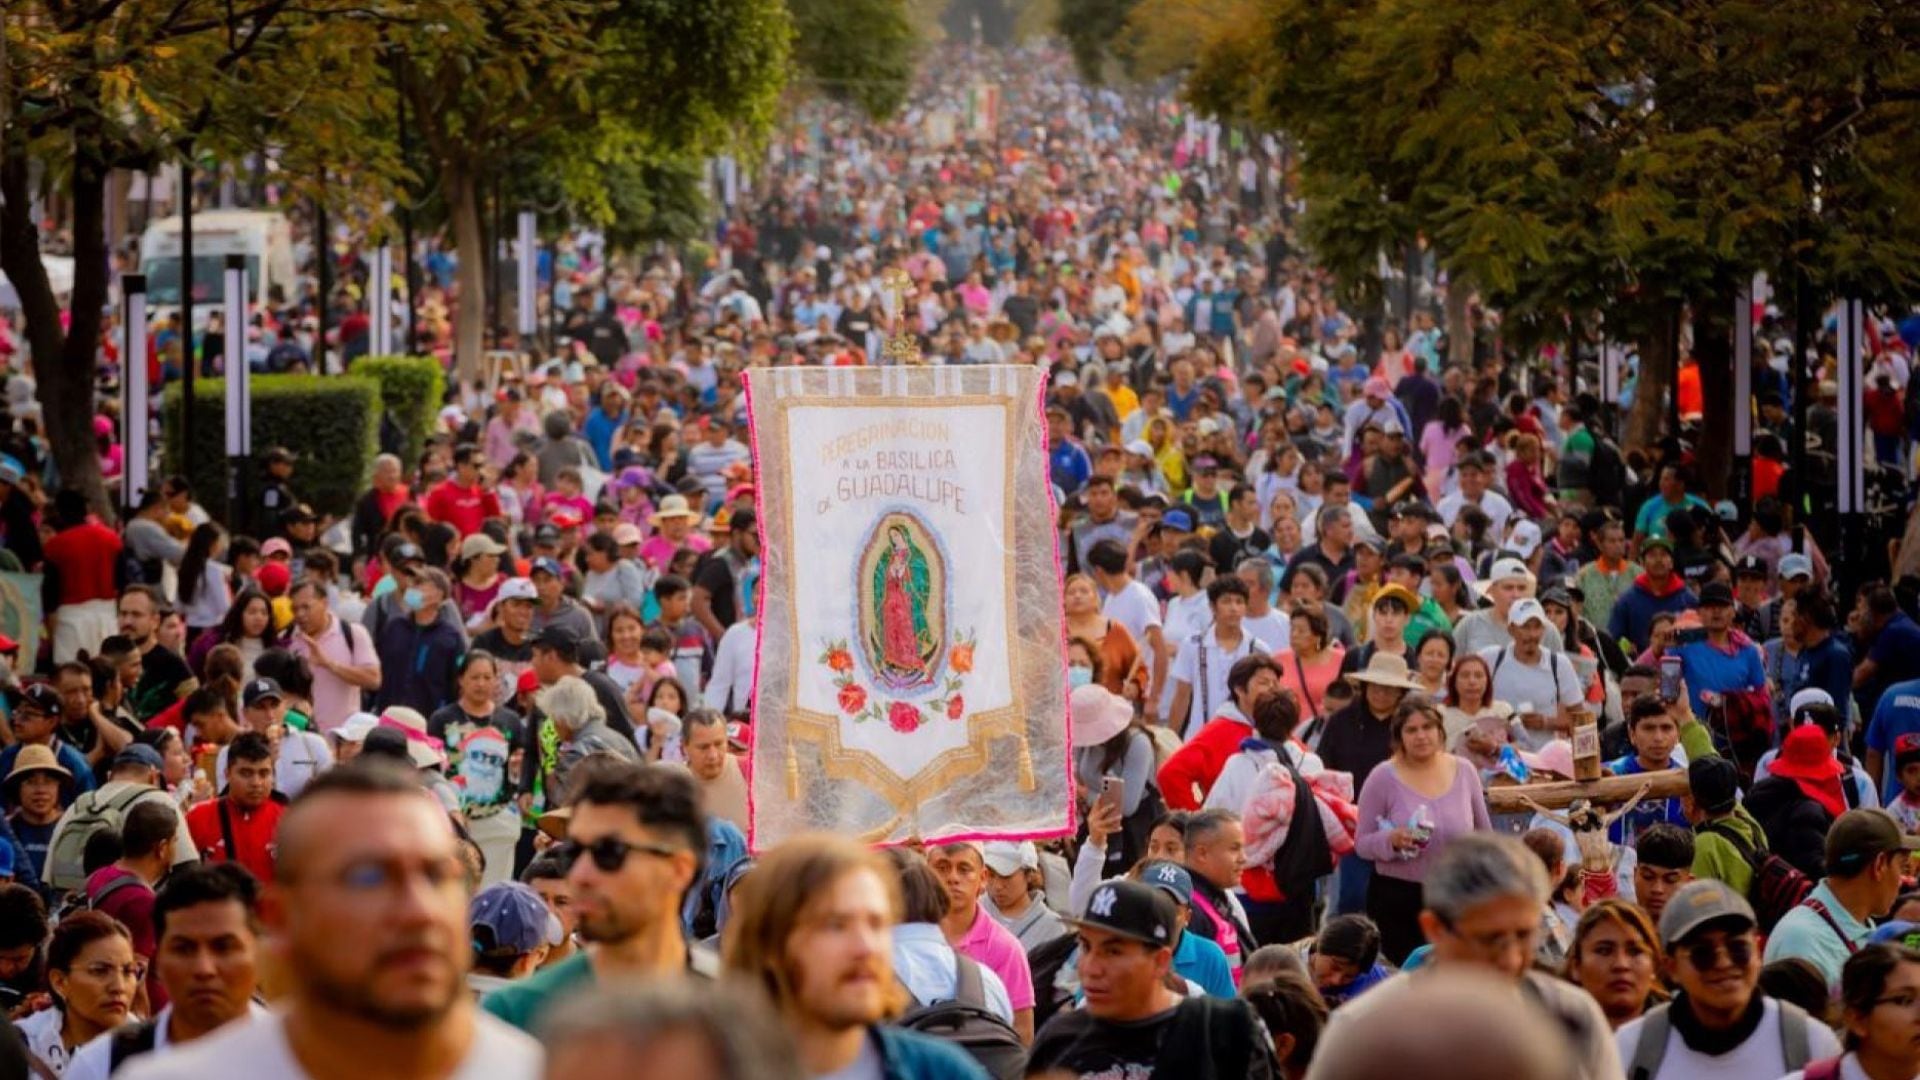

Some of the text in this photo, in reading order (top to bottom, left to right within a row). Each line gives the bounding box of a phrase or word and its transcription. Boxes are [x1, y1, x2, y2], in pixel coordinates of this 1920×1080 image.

[821, 417, 950, 464] PEREGRINACION
[842, 448, 957, 471] A LA BASILICA
[836, 473, 967, 515] GUADALUPE
